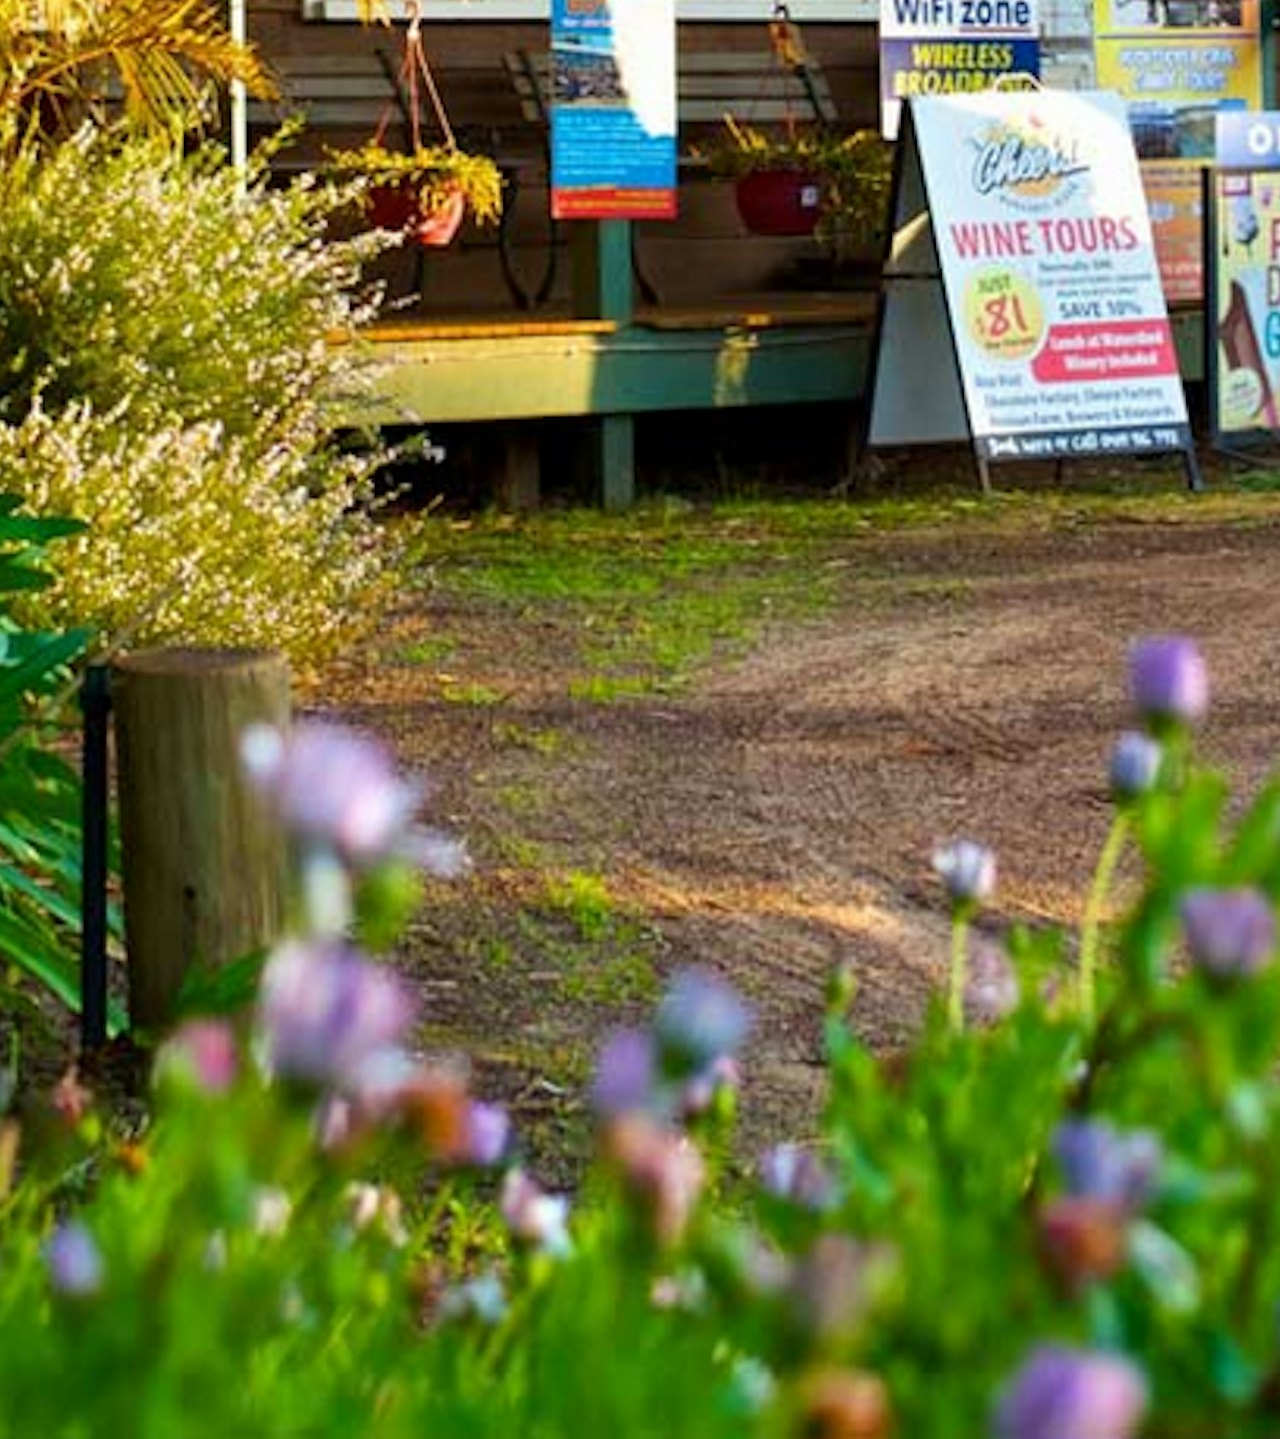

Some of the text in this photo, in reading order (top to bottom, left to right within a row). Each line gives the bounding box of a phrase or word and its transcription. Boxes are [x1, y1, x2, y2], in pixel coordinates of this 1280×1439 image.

[912, 44, 1013, 68] WIRELESS
[951, 216, 1138, 259] WINE TOURS
[977, 273, 1011, 294] JUST
[1059, 300, 1102, 319] SAVE
